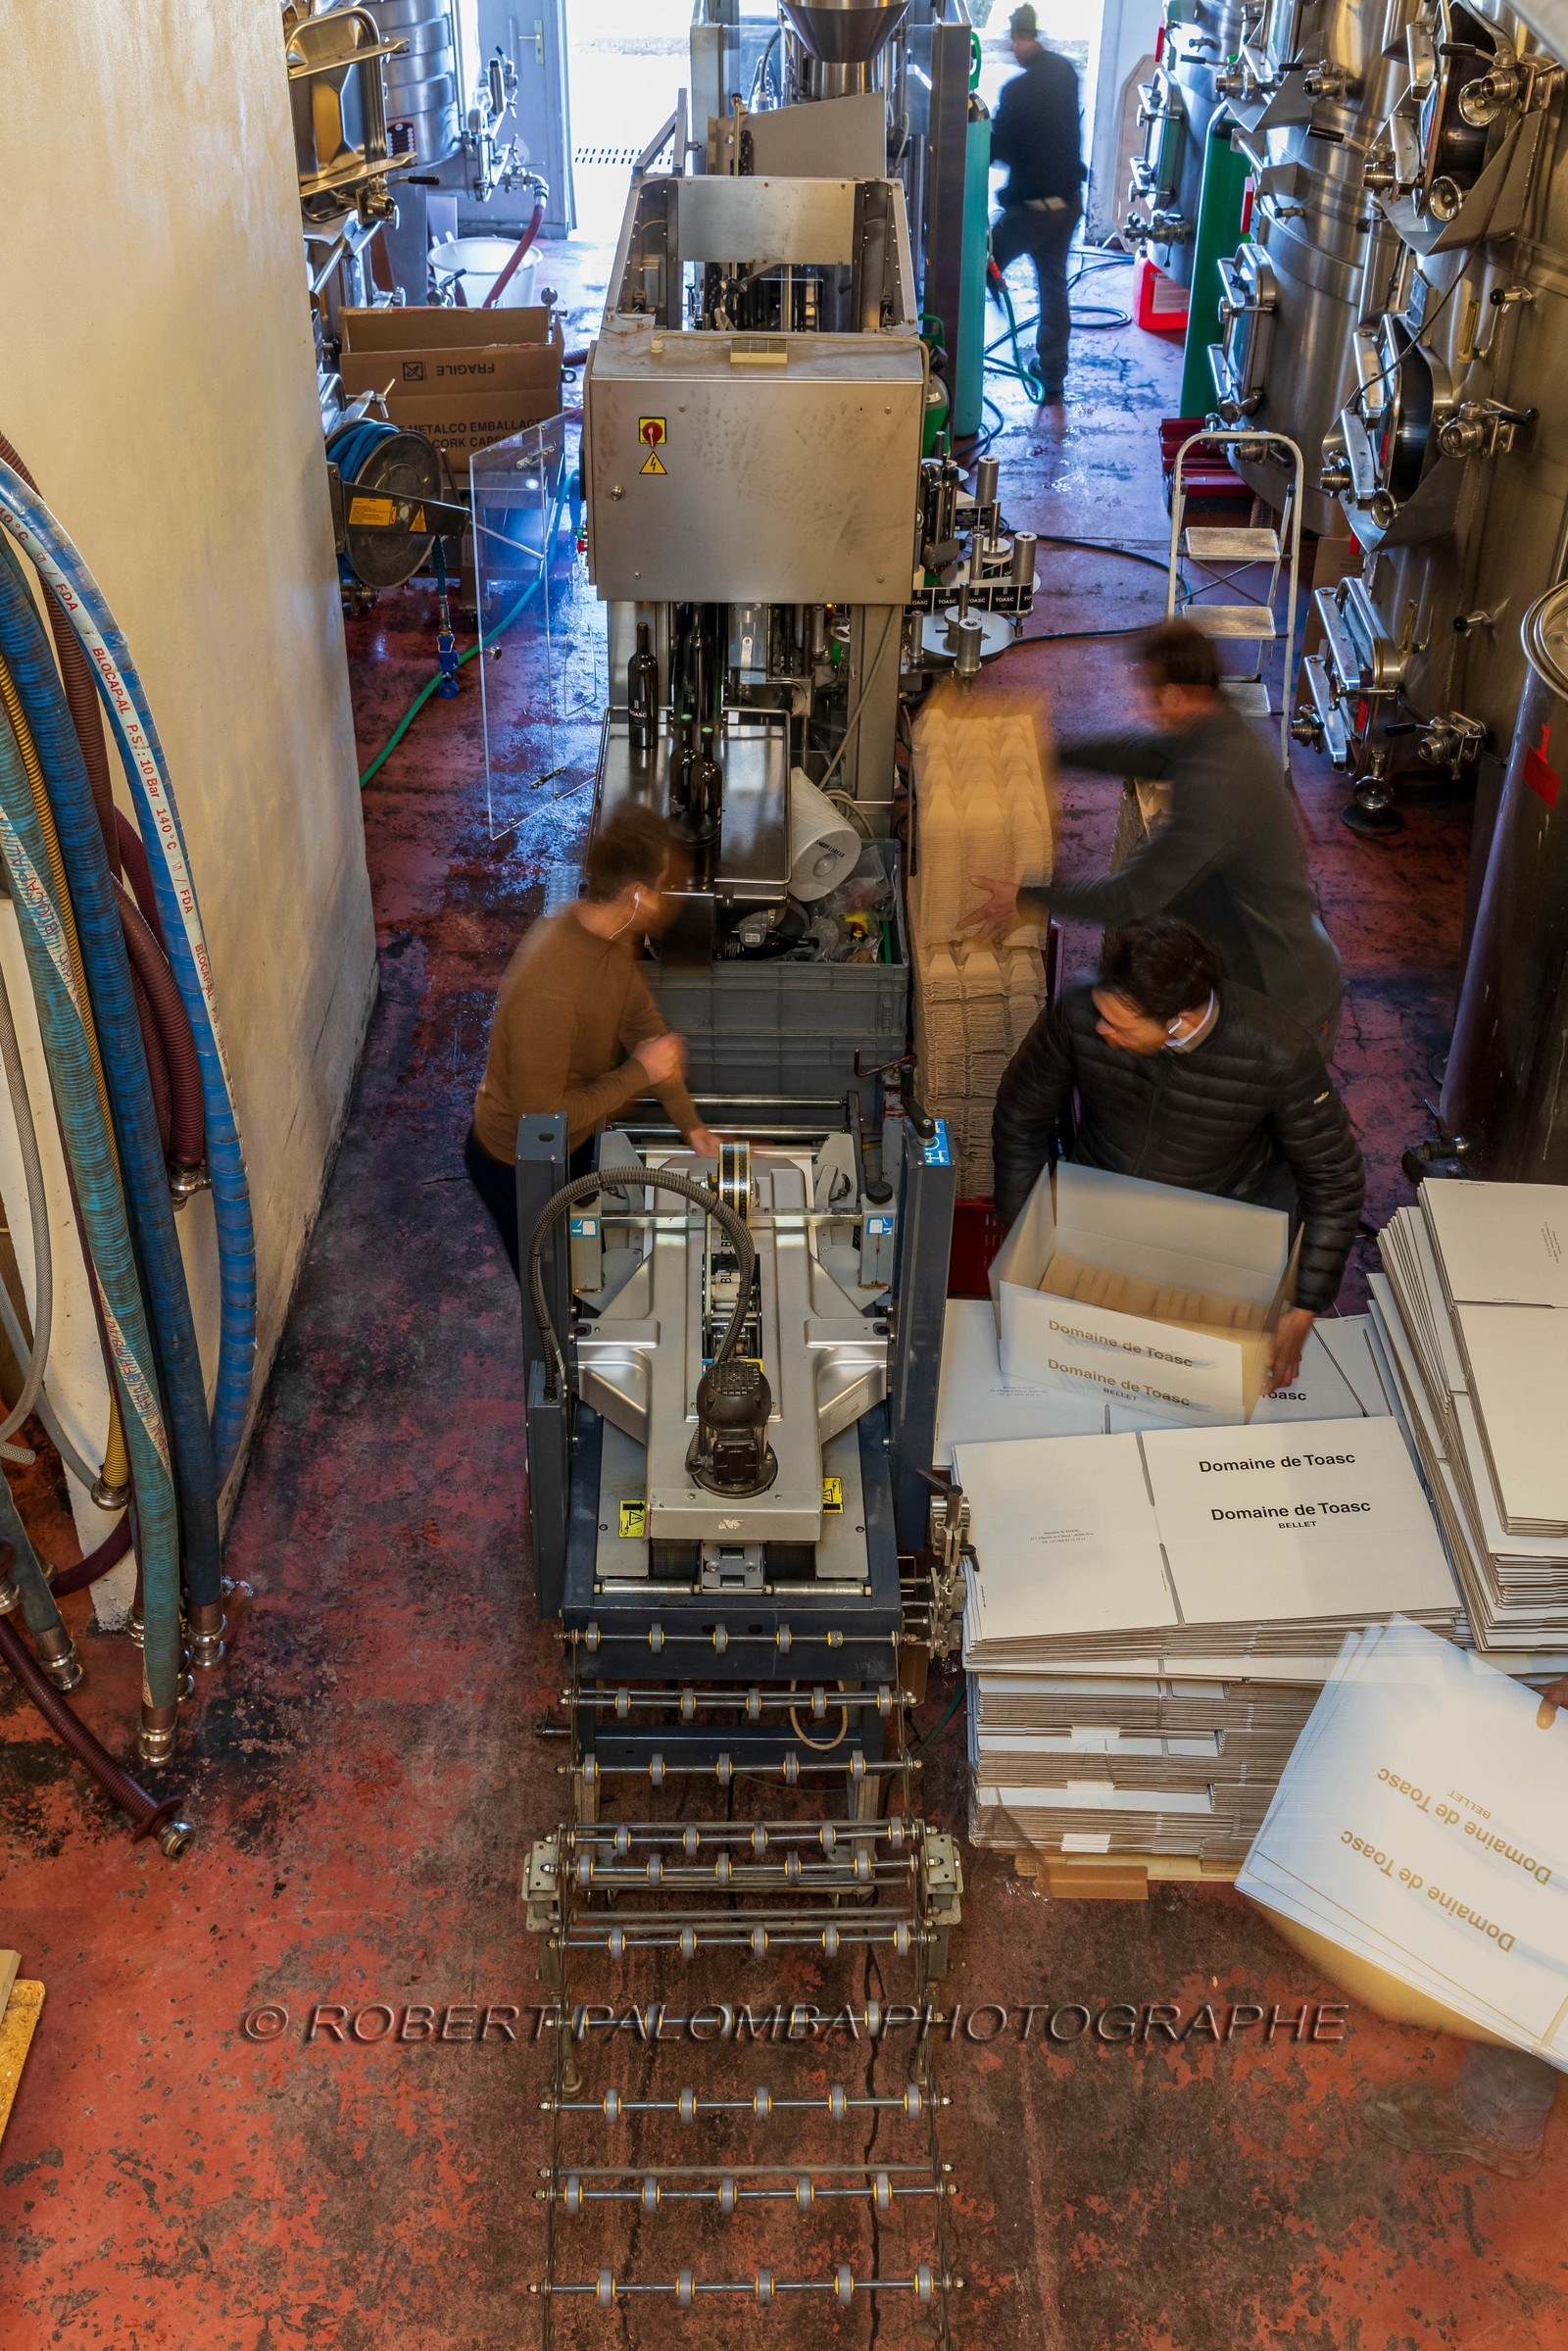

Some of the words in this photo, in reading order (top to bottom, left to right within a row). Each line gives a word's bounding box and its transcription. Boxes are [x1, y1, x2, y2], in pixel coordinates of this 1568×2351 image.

[436, 363, 495, 376] FRAGILE
[432, 438, 466, 449] CORK
[56, 583, 79, 612] FDA
[92, 648, 130, 714] BLOCAP-AL
[147, 776, 160, 799] Bar
[179, 889, 193, 914] FDA
[720, 1249, 732, 1285] BLANC
[1049, 1319, 1118, 1347] Domaine
[1123, 1341, 1143, 1354] de
[1145, 1347, 1194, 1368] Toasc
[1048, 1358, 1116, 1386] Domaine
[1121, 1380, 1141, 1394] de
[1143, 1385, 1191, 1407] Toasc
[1103, 1388, 1138, 1401] BELLET
[1261, 1392, 1307, 1400] oasc
[1199, 1457, 1276, 1472] Domaine
[1280, 1456, 1301, 1468] de
[1303, 1454, 1356, 1466] Toasc
[1211, 1506, 1290, 1521] Domaine
[1294, 1504, 1316, 1516] de
[1318, 1502, 1371, 1515] Toasc
[1377, 1768, 1432, 1813] Toasc
[1447, 1789, 1492, 1820] BELLET
[1435, 1803, 1460, 1825] de
[1341, 1831, 1396, 1878] Toasc
[1464, 1821, 1552, 1886] Domaine
[1398, 1867, 1424, 1889] de
[1427, 1886, 1516, 1952] Domaine
